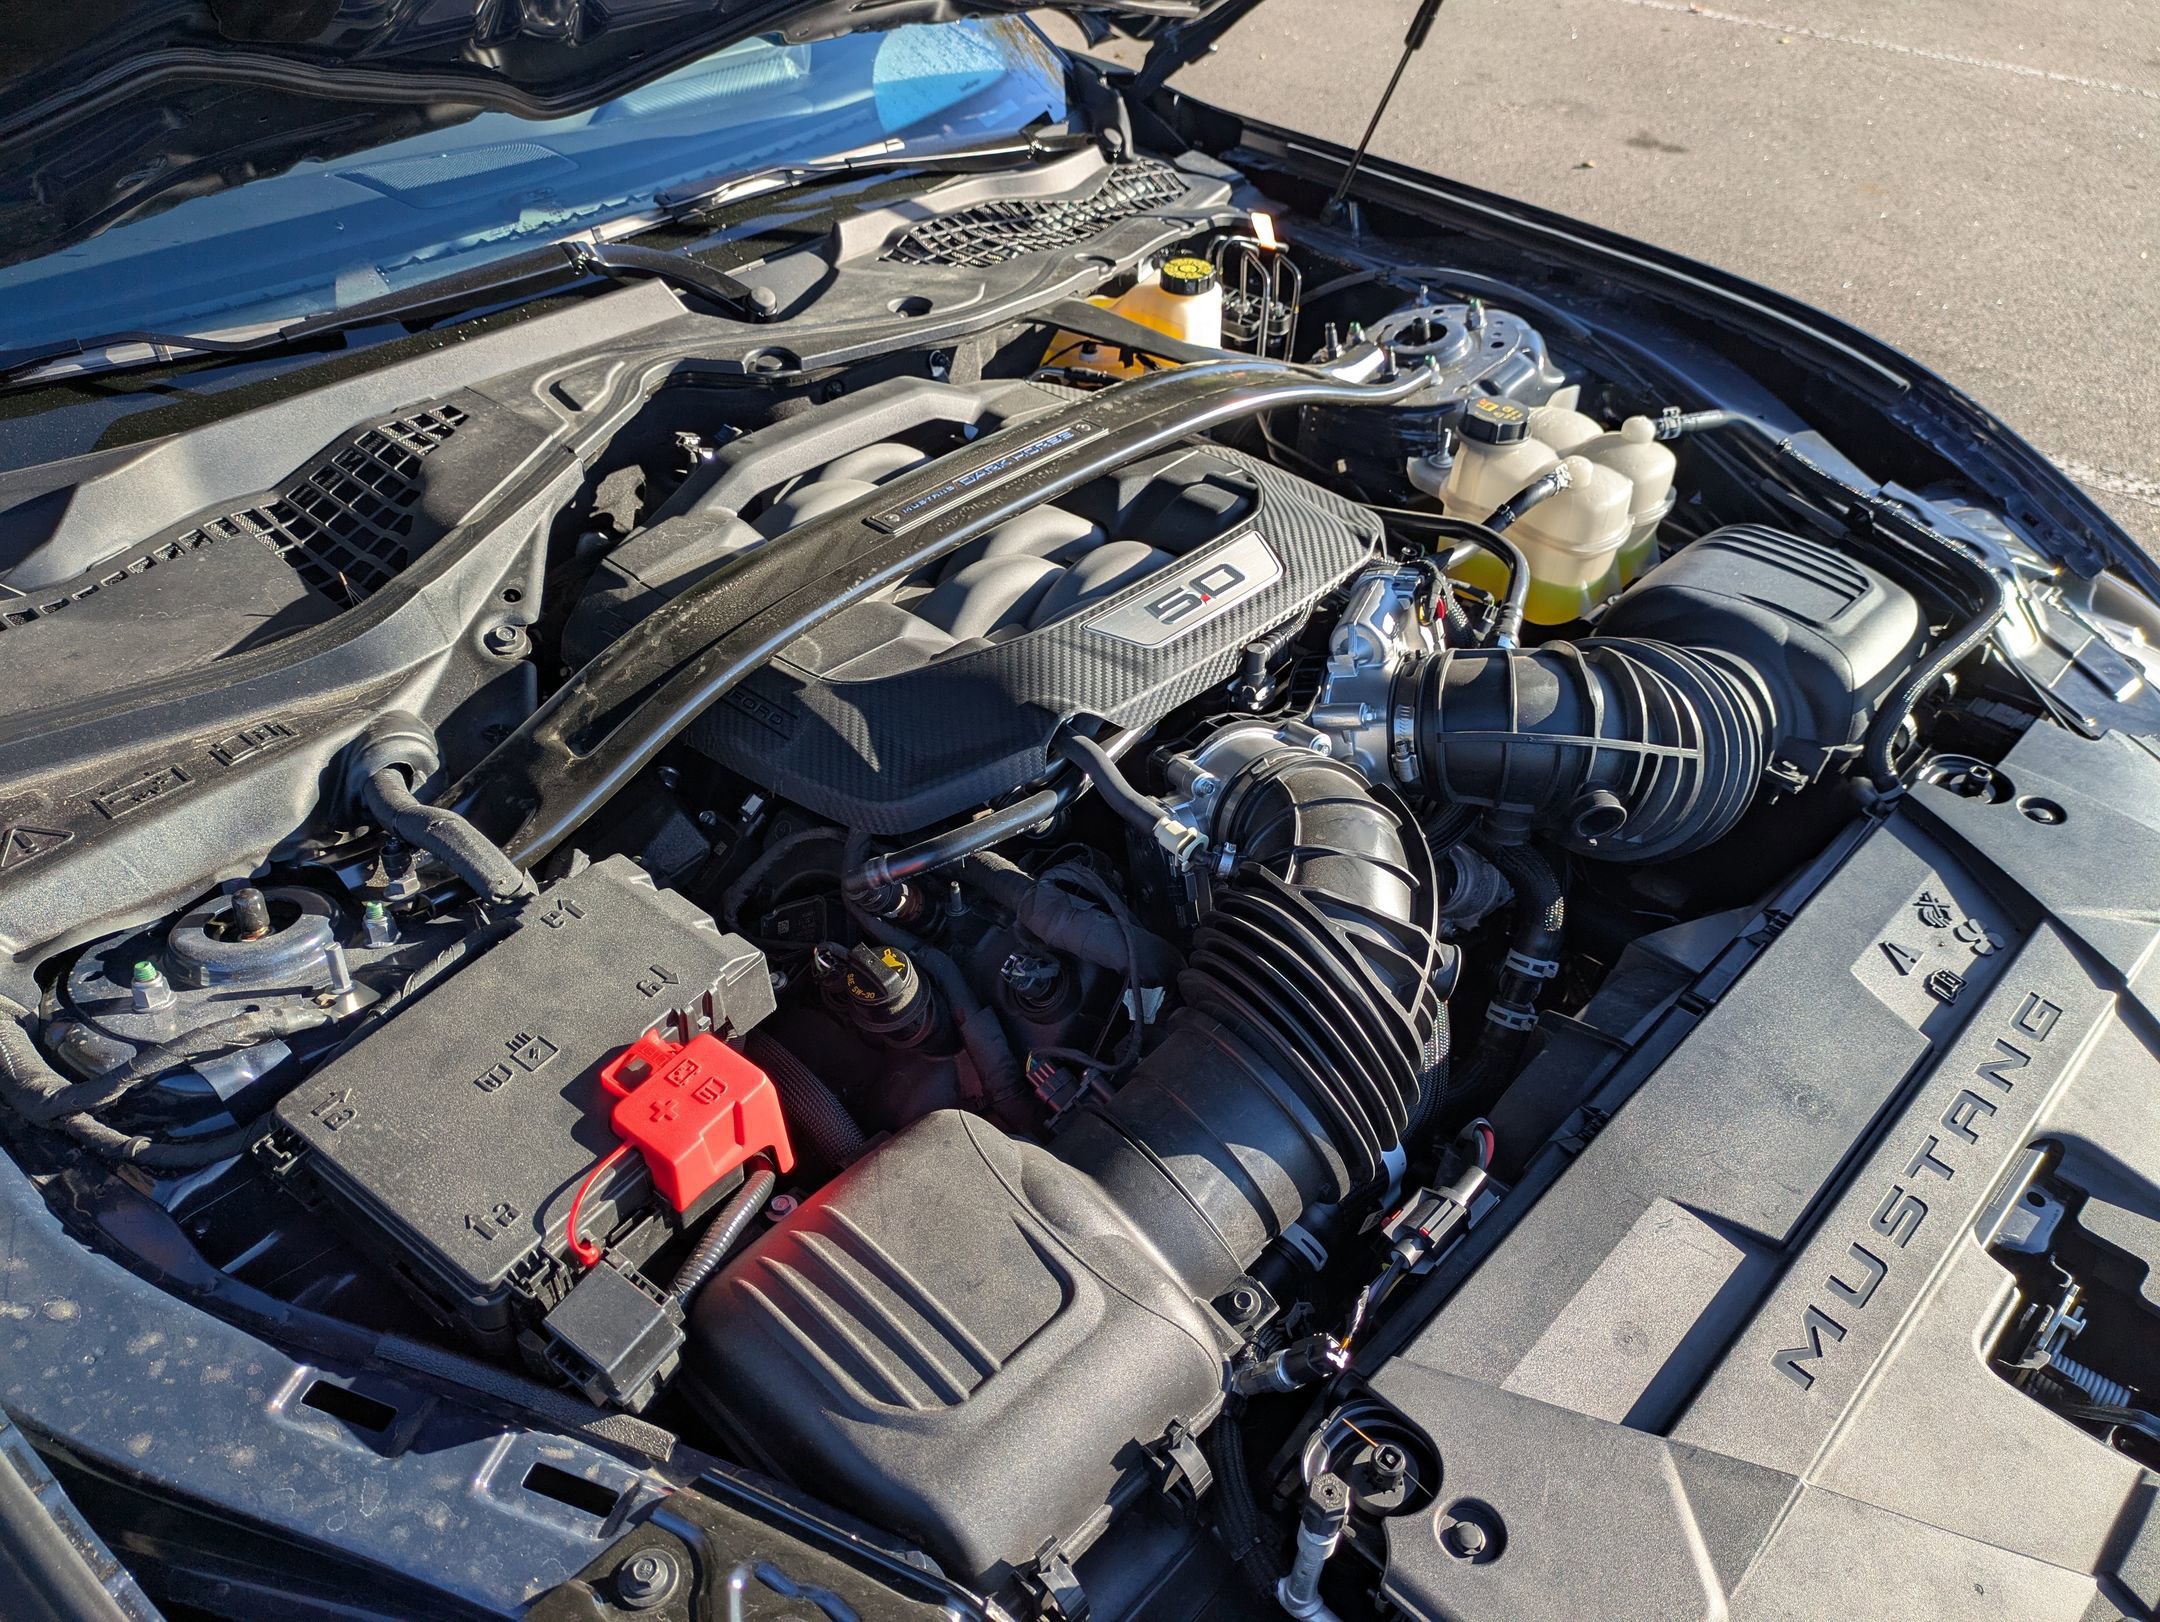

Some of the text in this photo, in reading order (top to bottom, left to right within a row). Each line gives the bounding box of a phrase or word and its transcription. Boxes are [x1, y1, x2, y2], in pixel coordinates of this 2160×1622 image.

[959, 458, 1013, 487] DARK
[1011, 431, 1075, 461] HORSE
[1143, 562, 1246, 625] 5.0
[728, 689, 784, 726] FORD
[847, 973, 875, 998] SAE 5W-30
[1769, 991, 2064, 1391] MUSTANG
